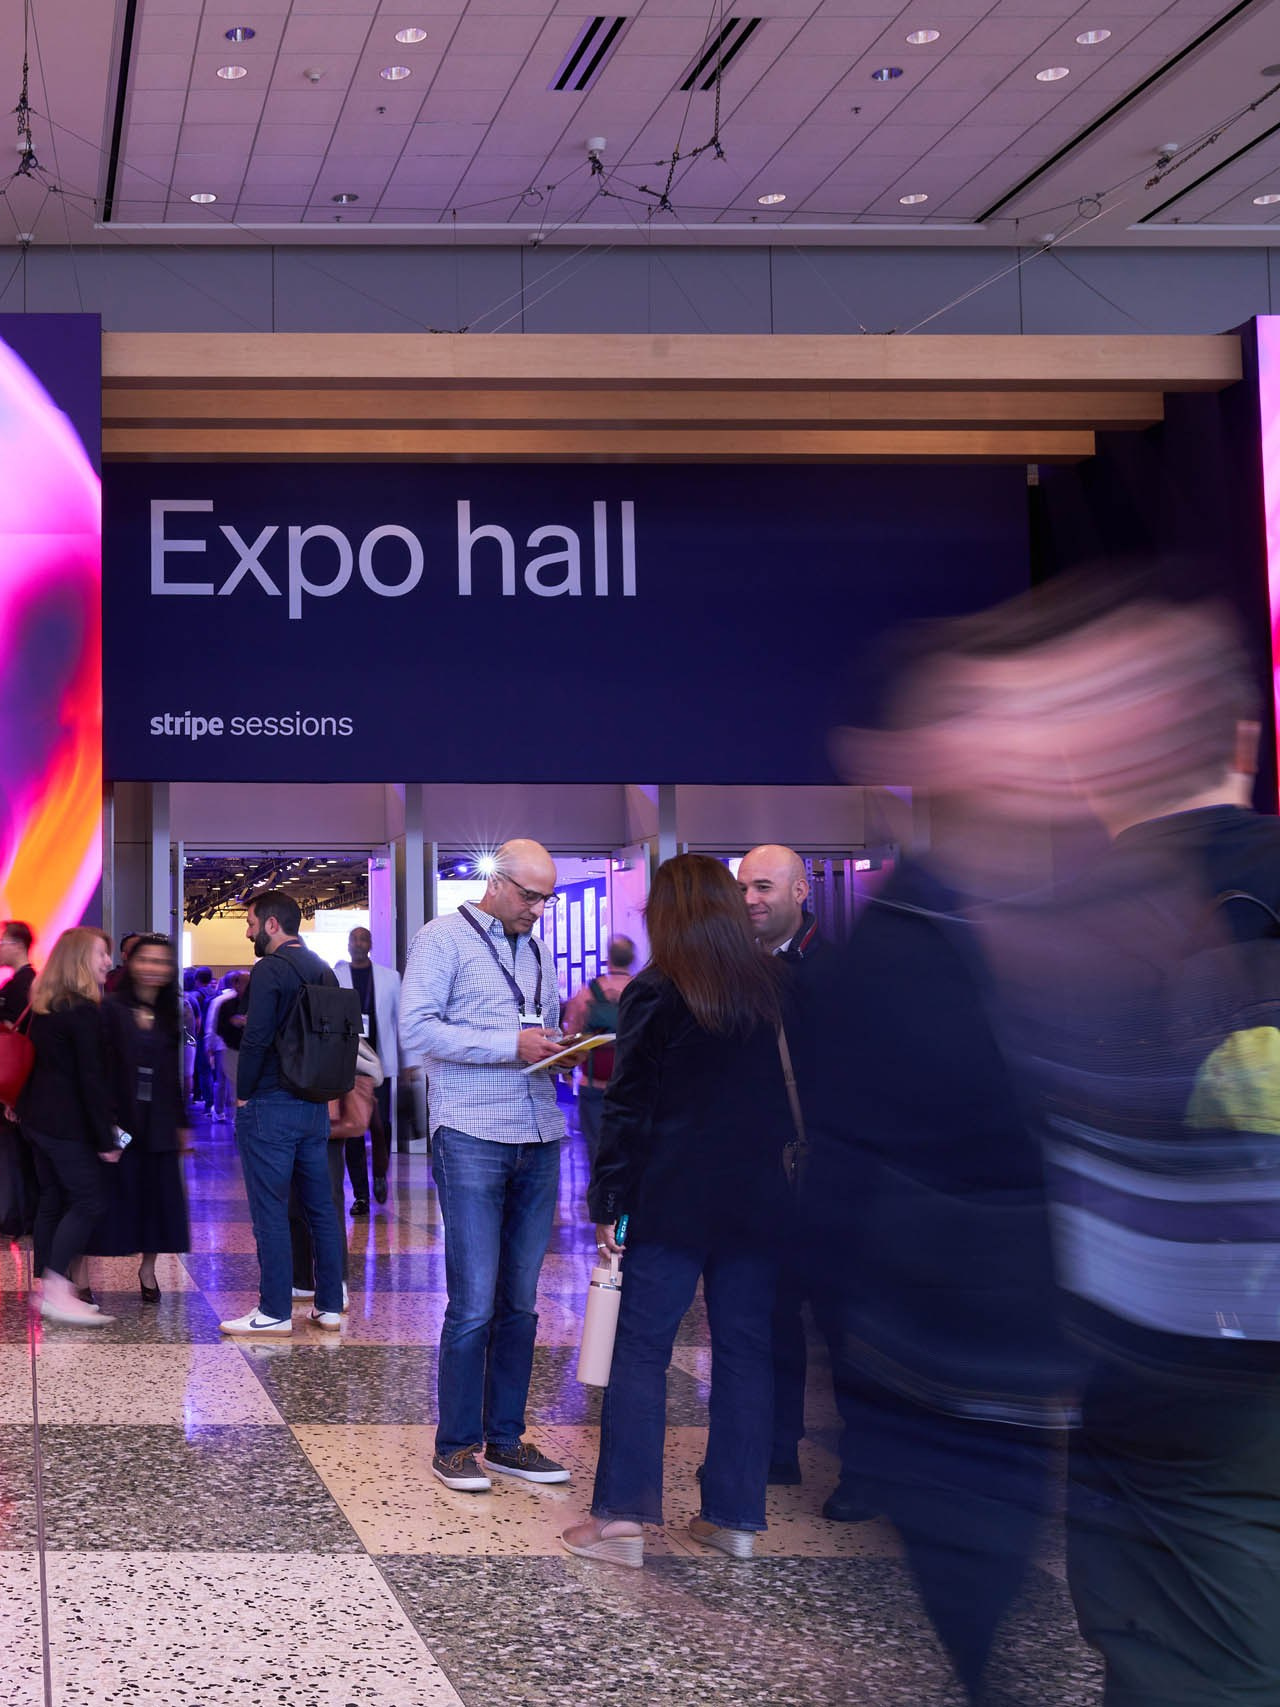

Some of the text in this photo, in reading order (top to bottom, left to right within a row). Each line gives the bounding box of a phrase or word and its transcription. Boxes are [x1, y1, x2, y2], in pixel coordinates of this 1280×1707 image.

[150, 499, 637, 620] Expo hall
[150, 710, 354, 741] stripe sessions
